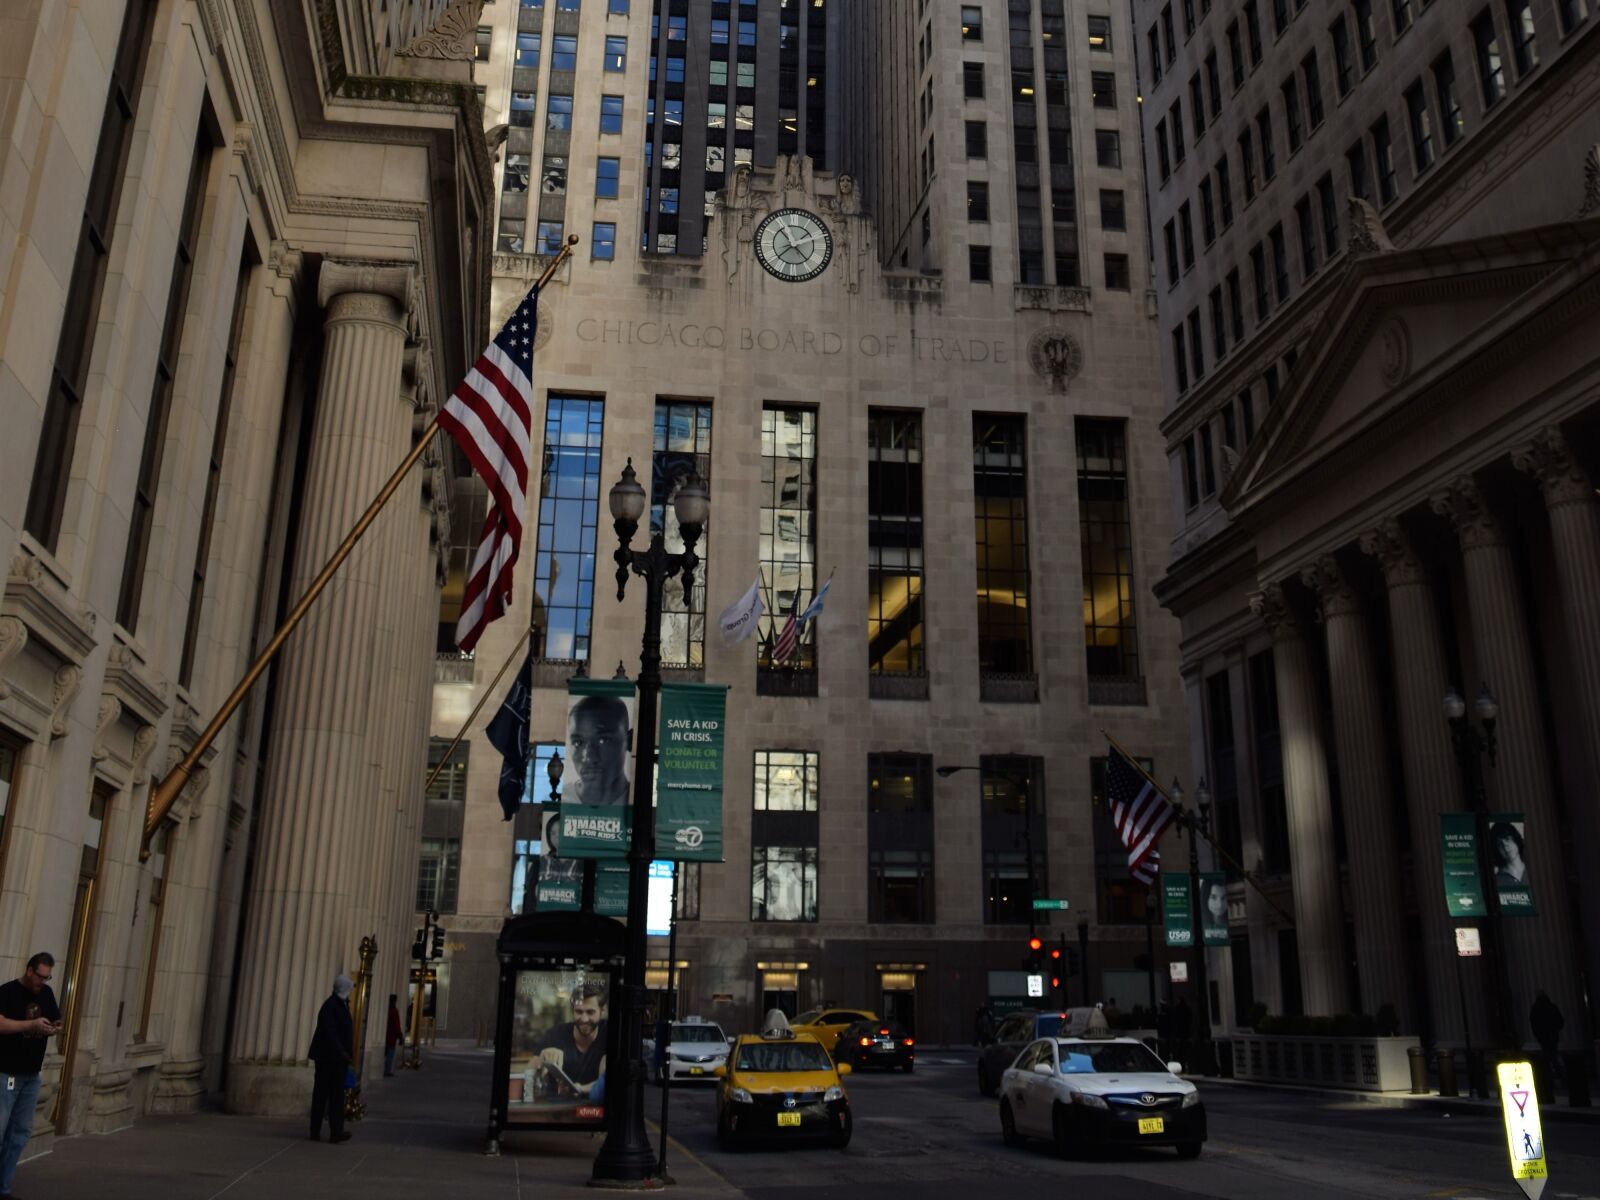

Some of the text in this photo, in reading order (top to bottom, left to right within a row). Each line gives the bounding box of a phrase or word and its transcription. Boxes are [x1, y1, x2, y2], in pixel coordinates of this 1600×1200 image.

[576, 318, 1008, 364] CHICAGO BOARD OF TRADE
[668, 719, 718, 730] SAVE A KID
[672, 732, 712, 742] IN CRISIS.
[666, 748, 717, 758] DONATE OR
[668, 782, 712, 790] mercyhome.org
[578, 819, 620, 833] MARCH
